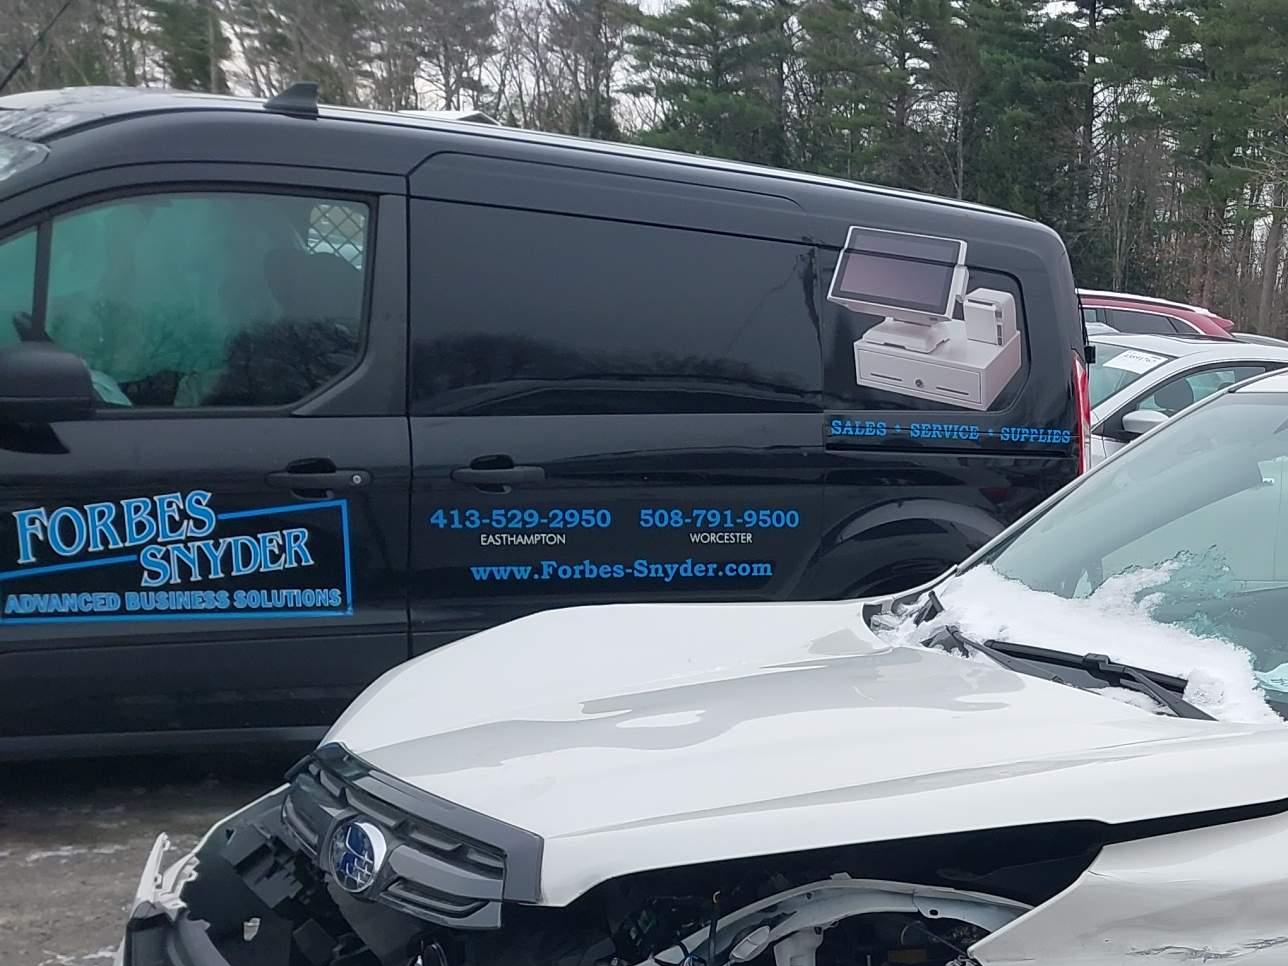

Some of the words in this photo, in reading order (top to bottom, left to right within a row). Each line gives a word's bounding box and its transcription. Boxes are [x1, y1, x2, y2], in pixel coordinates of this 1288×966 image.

[831, 420, 887, 436] SALES
[910, 423, 979, 440] SERVICE
[1000, 427, 1071, 443] SUPPLIES
[12, 490, 217, 564] FORBES
[430, 508, 612, 529] 413-529-2950
[639, 508, 800, 529] 508-791-9500
[480, 533, 566, 546] EASTHAMPTON
[690, 532, 753, 545] WORCESTER
[140, 528, 314, 588] SNYDER
[470, 559, 773, 582] www.Forbes-Snyder.com
[5, 592, 121, 614] ADVANCED
[125, 590, 230, 612] BUSINESS
[233, 588, 342, 608] SOLUTIONS
